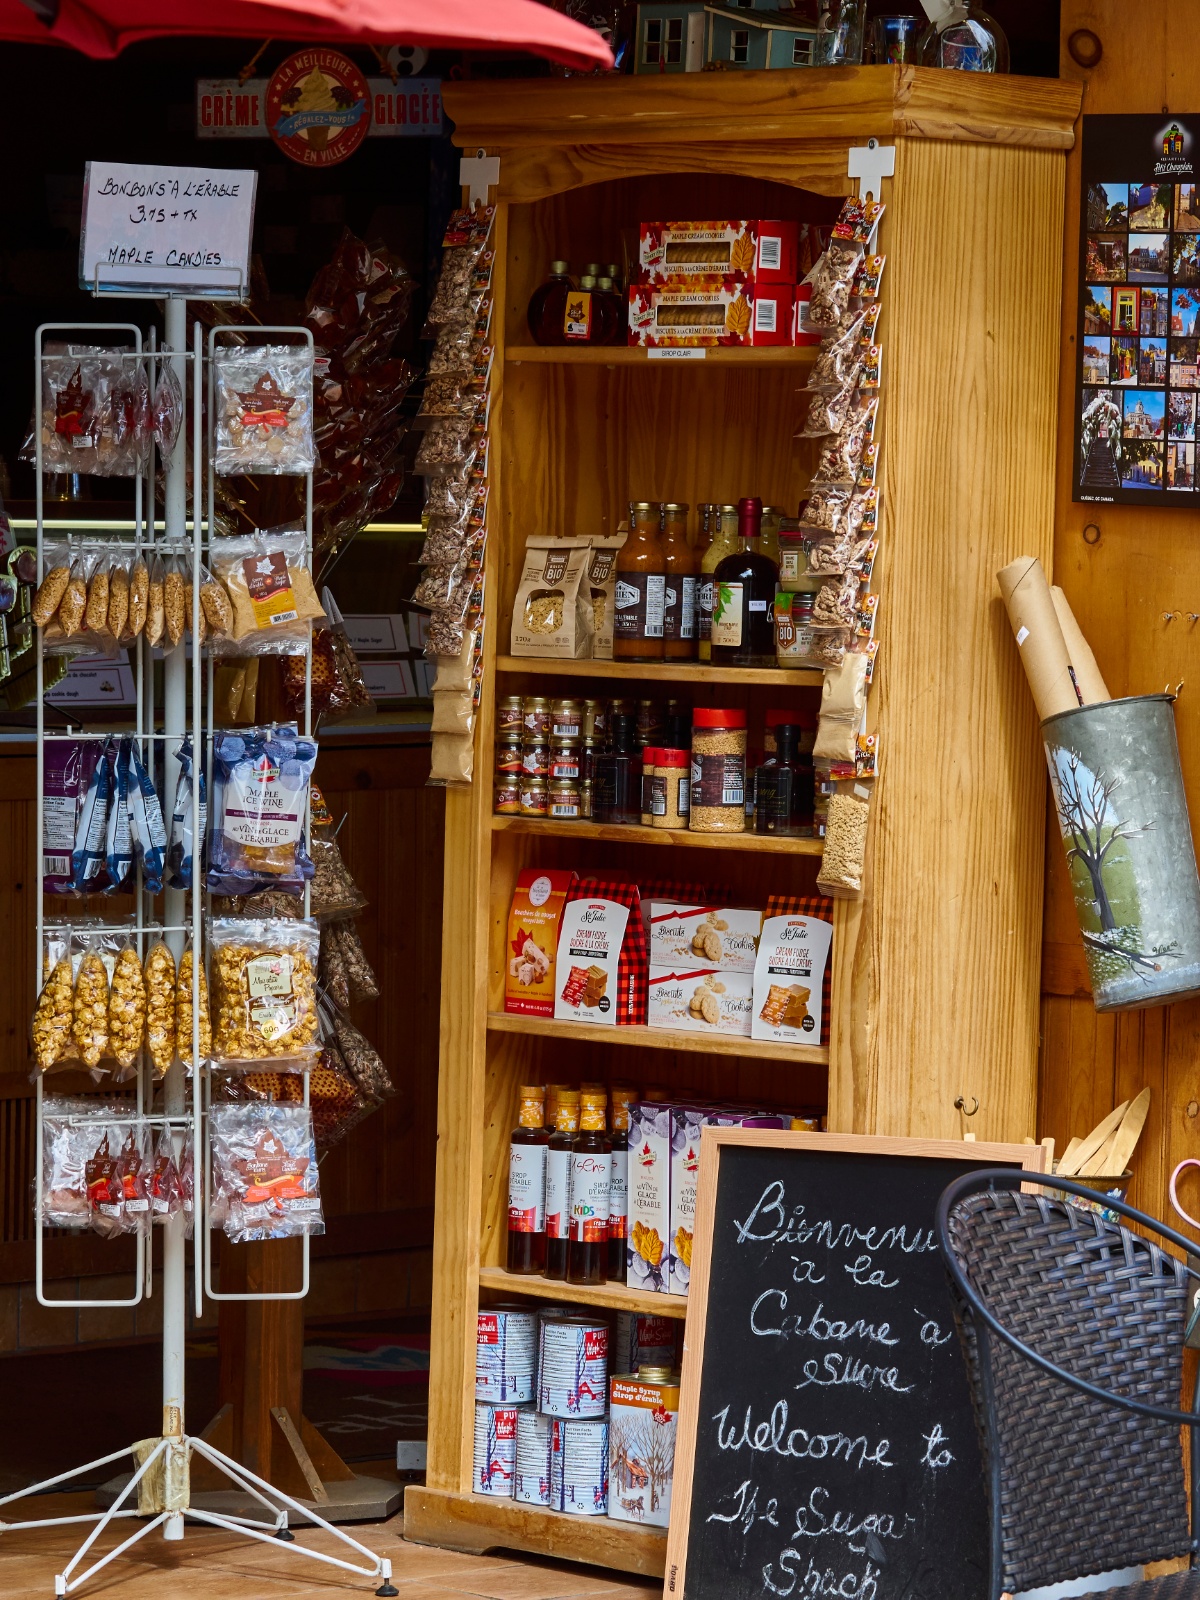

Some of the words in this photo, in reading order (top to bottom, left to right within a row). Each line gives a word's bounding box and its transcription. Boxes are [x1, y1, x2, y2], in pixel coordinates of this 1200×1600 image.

[279, 66, 294, 83] LA
[296, 53, 352, 77] MEILLEURE
[201, 89, 259, 127] CRÈME
[374, 88, 440, 125] GLACÉE
[303, 149, 317, 162] EN
[320, 142, 348, 162] VILLE
[98, 177, 166, 198] BONBONS
[183, 209, 198, 222] TX
[671, 232, 687, 240] MAPLE
[688, 232, 705, 240] CREAM
[108, 246, 154, 268] MAPLE
[165, 249, 222, 267] CANDIES
[693, 264, 709, 272] CRÈME
[709, 264, 730, 272] D'ÉRABLE
[686, 327, 702, 335] CRÈME
[703, 327, 725, 335] D'ÉRABLE
[547, 569, 563, 579] BIO
[592, 568, 608, 579] BIO
[780, 627, 792, 640] BIO
[246, 785, 279, 798] MAPLE
[243, 797, 257, 805] ICE
[260, 798, 284, 809] WINE
[261, 827, 290, 836] GLACE
[576, 929, 592, 939] CREAM
[592, 930, 607, 941] FUDGE
[652, 925, 686, 940] Biscuits
[569, 938, 584, 948] SUCRE
[724, 936, 756, 951] Cookies
[775, 946, 793, 957] CREAM
[793, 947, 810, 958] FUDGE
[768, 955, 784, 966] SUCRE
[650, 987, 684, 1002] Biscuits
[721, 999, 753, 1013] Cookies
[511, 1171, 528, 1179] SIROP
[637, 1190, 657, 1200] GLACE
[681, 1195, 697, 1204] GLAC
[573, 1204, 595, 1217] KIDS
[680, 1203, 695, 1215] L'ÉRA
[790, 1255, 826, 1283] à
[844, 1255, 900, 1288] la
[645, 1317, 666, 1328] PURE
[750, 1288, 900, 1346] Cabane
[913, 1307, 952, 1344] à
[615, 1383, 638, 1394] Maple
[639, 1386, 661, 1398] Syrup
[613, 1390, 634, 1401] Sirop
[635, 1394, 663, 1405] d'érable
[711, 1399, 899, 1469] Welcome
[920, 1423, 956, 1468] to
[705, 1480, 779, 1535] The
[790, 1485, 917, 1555] Sugar
